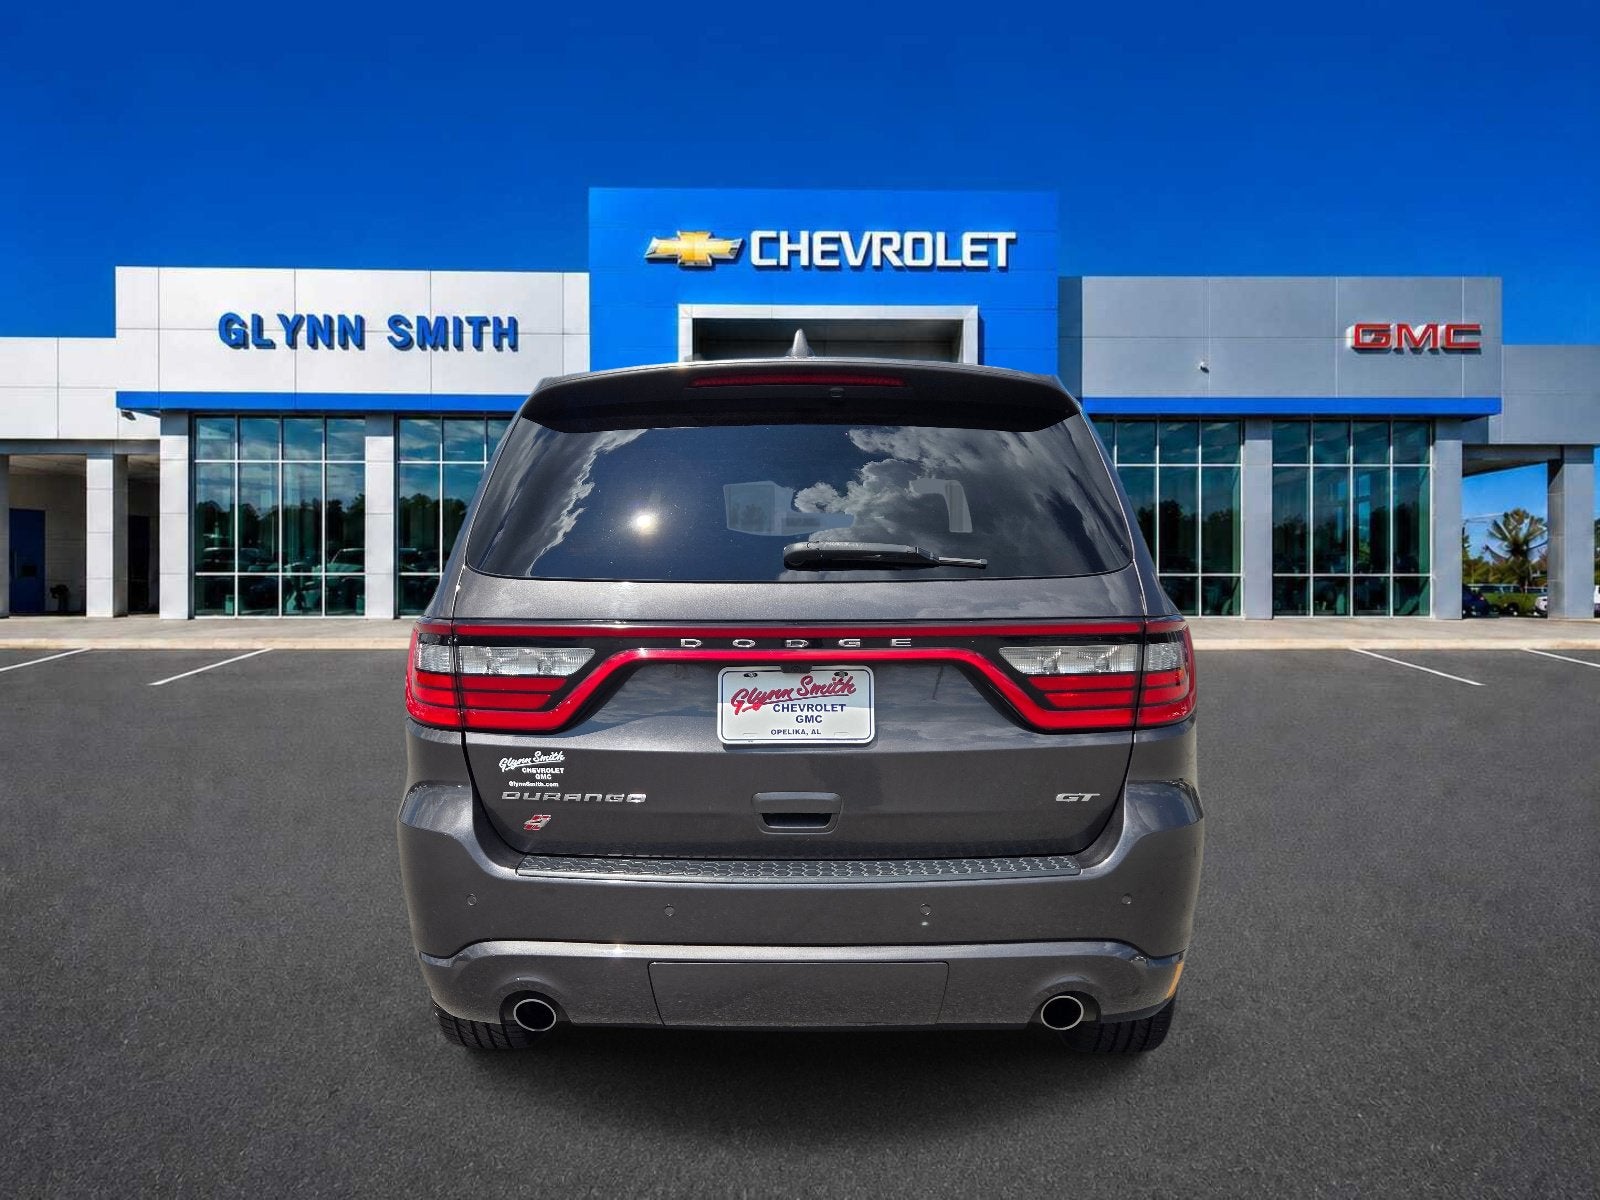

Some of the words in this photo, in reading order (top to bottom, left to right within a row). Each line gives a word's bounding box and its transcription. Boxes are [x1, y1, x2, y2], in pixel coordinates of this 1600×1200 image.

[750, 230, 1017, 267] CHEVROLET
[218, 312, 365, 350] GLYNN
[387, 314, 519, 352] SMITH
[1348, 323, 1482, 353] GMC
[680, 638, 912, 648] DODGE
[730, 686, 794, 715] Glynn
[796, 675, 857, 697] Smith
[773, 703, 846, 713] CHEVROLET
[795, 714, 823, 724] GMC
[770, 728, 809, 736] OPELIKA,
[499, 758, 532, 772] Glynn
[533, 751, 566, 763] Smith
[501, 791, 647, 803] DURANGO
[1055, 793, 1101, 802] GT
